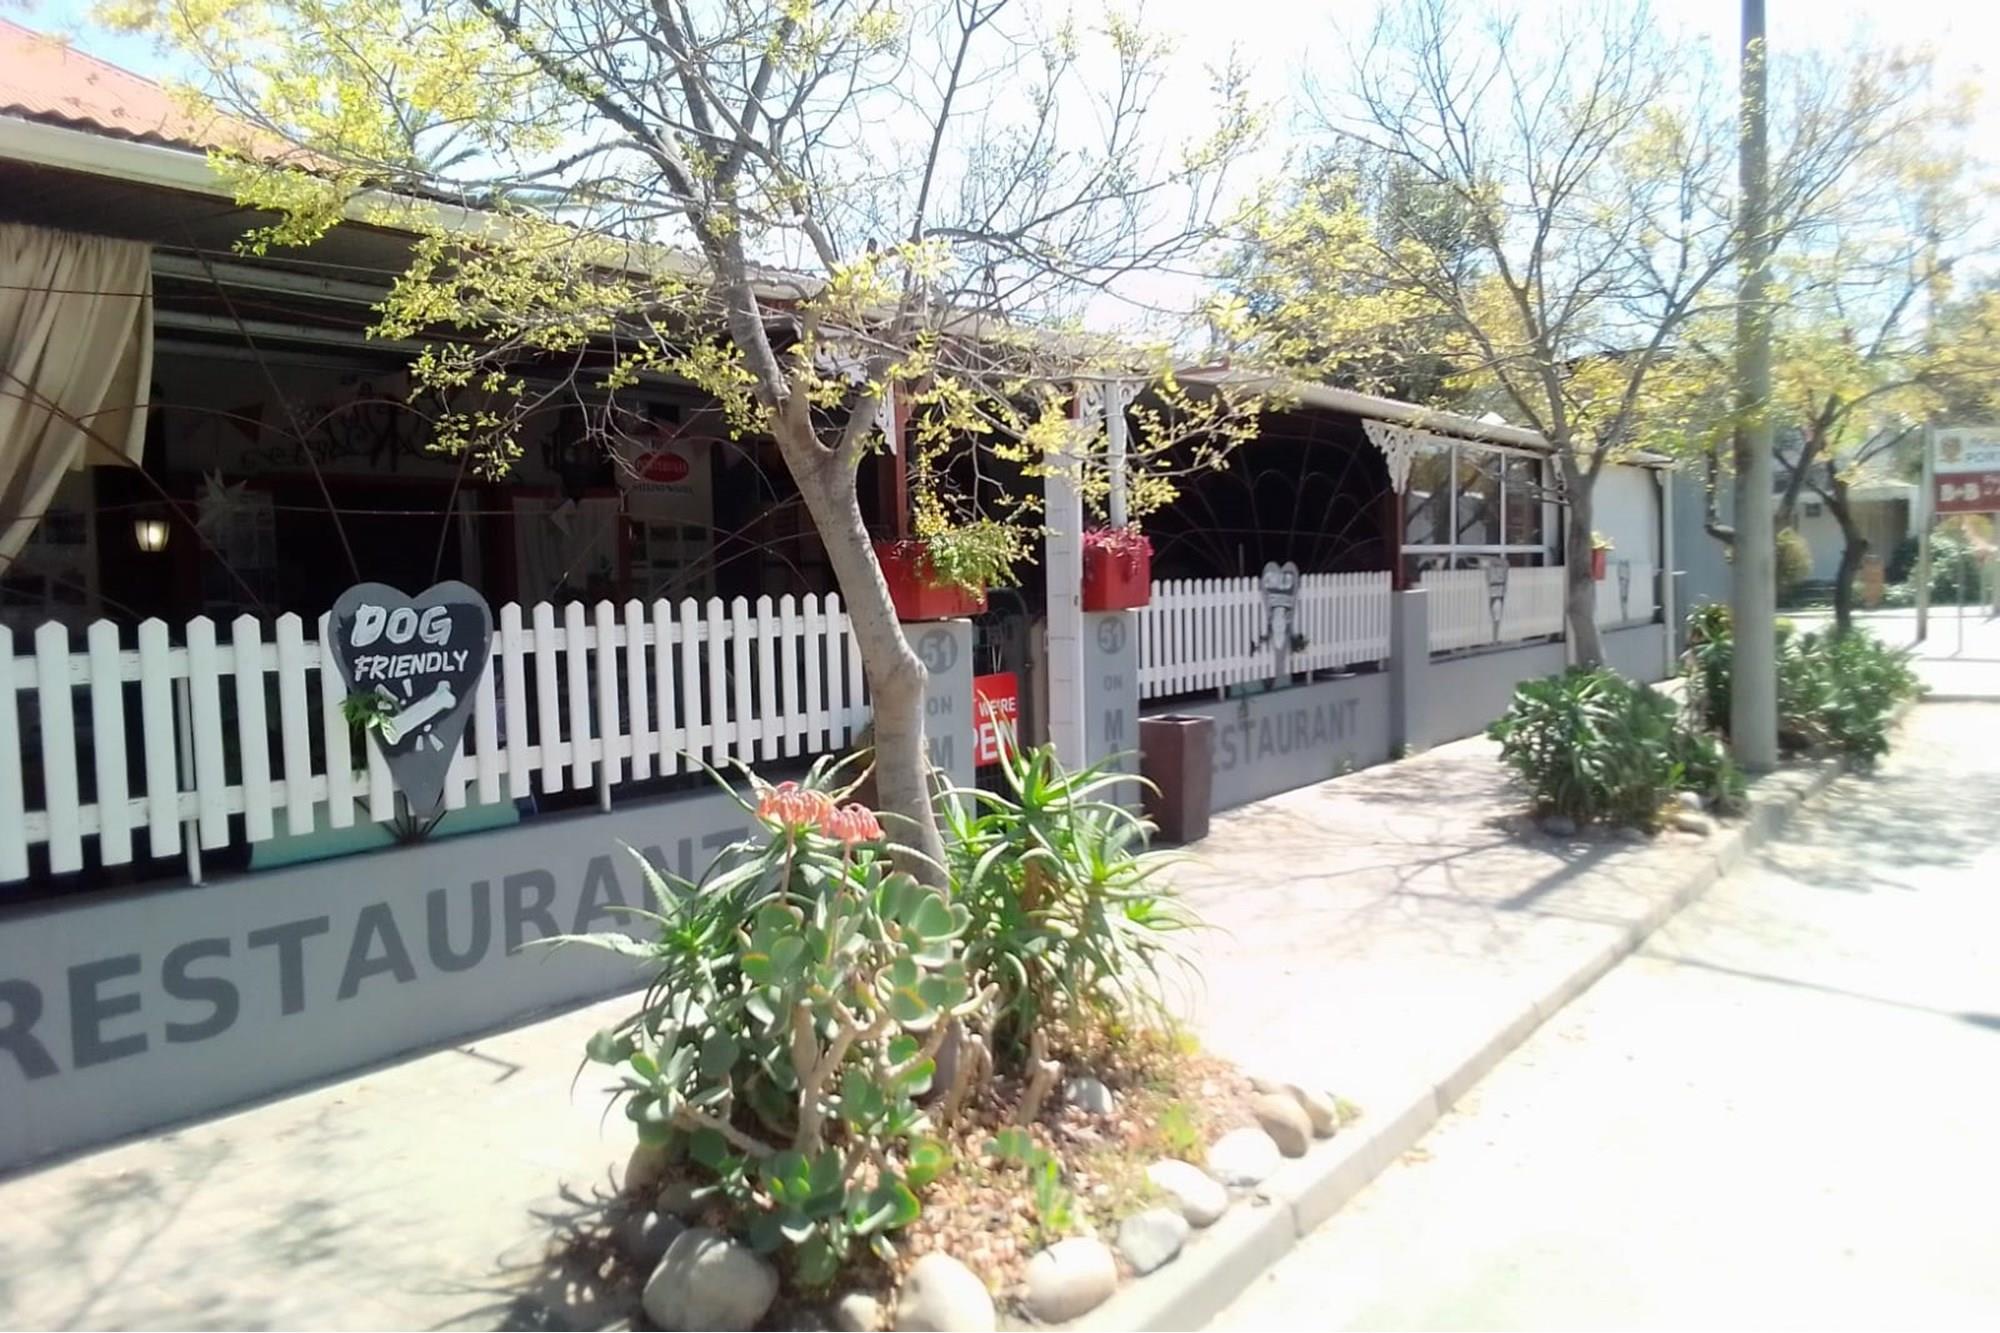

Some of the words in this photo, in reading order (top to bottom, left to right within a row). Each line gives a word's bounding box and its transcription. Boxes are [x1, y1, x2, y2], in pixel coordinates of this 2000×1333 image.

[351, 603, 452, 648] DOG
[354, 649, 469, 682] FRIENDLY
[921, 631, 956, 670] 51
[1103, 674, 1122, 692] ON
[926, 695, 953, 716] ON
[1212, 699, 1361, 773] STAURANT
